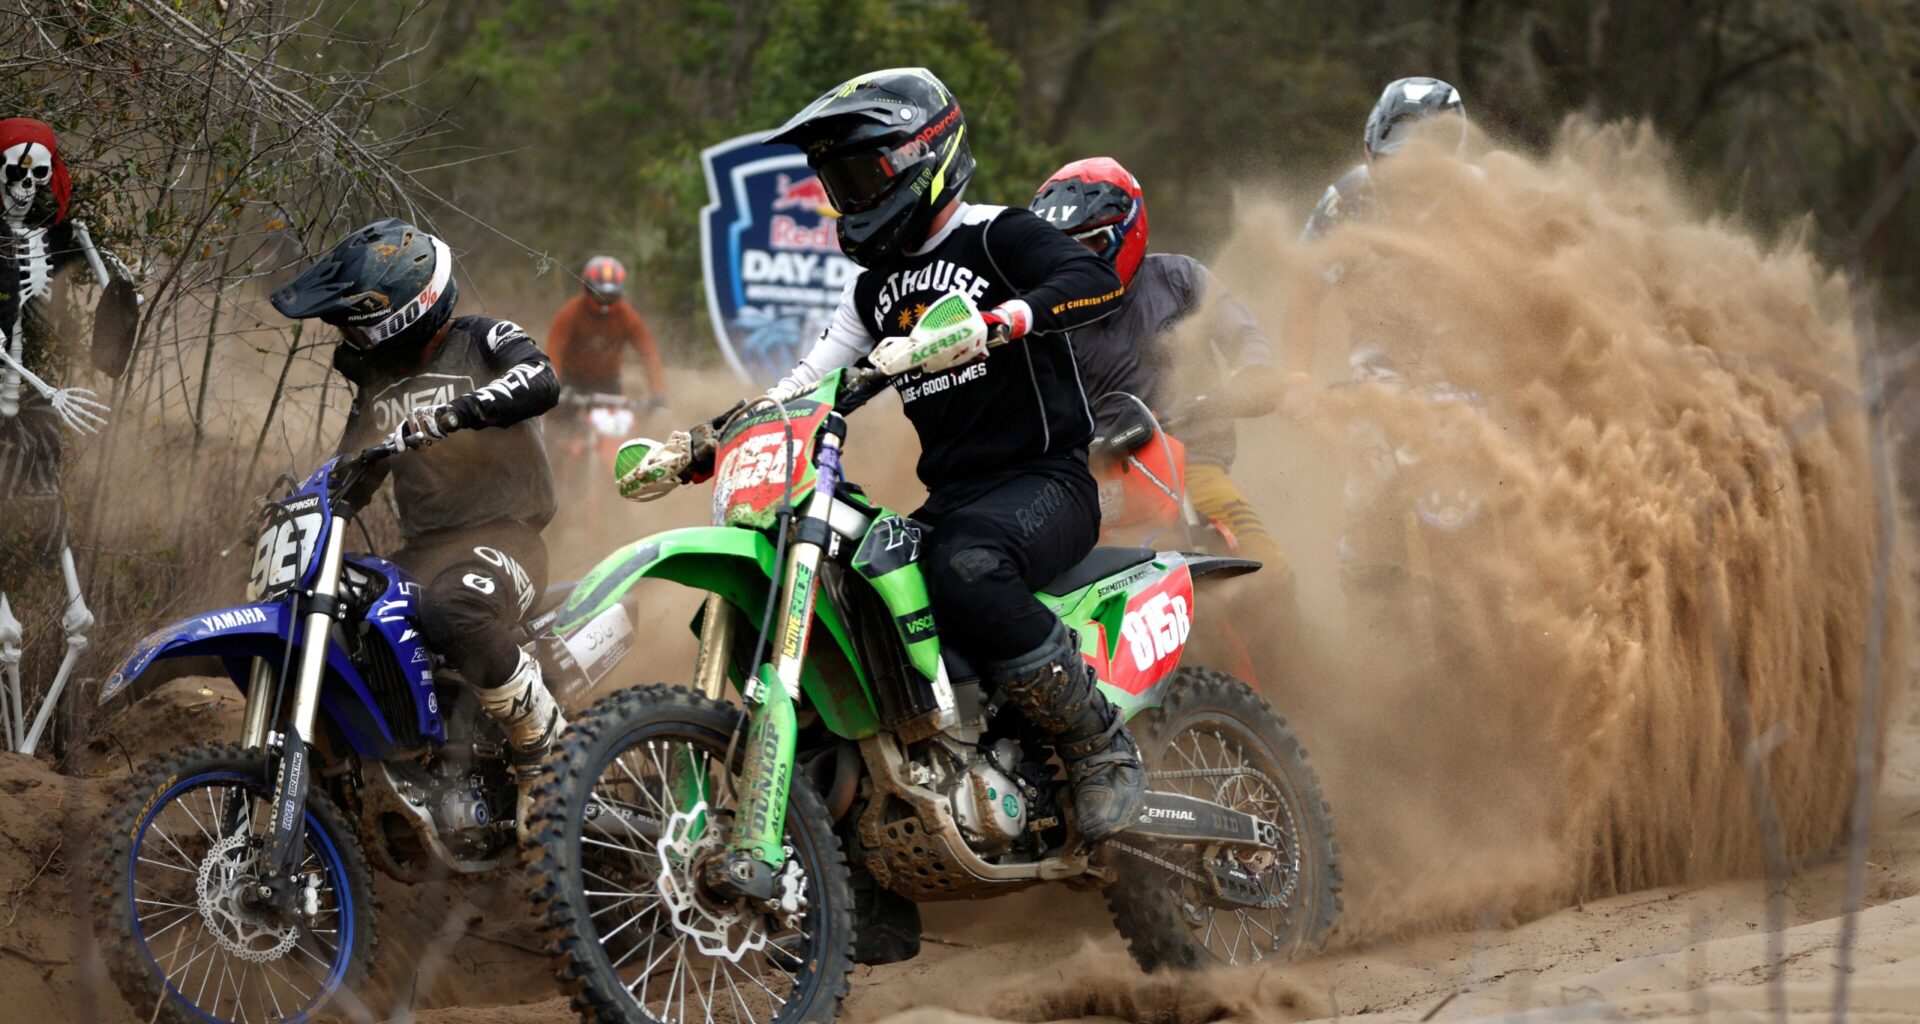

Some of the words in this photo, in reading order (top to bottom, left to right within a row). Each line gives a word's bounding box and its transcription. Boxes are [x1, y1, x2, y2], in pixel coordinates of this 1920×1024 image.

[910, 167, 934, 197] FLY
[770, 214, 829, 249] Red
[376, 284, 437, 339] 100%
[1051, 302, 1066, 315] WE
[1067, 297, 1102, 309] CHERISH
[910, 327, 974, 365] ACERBIS
[922, 375, 951, 397] GOOD
[201, 607, 267, 632] YAMAHA
[1121, 591, 1190, 672] 815B
[289, 752, 302, 797] BRAKING
[754, 721, 779, 836] DUNLOP
[269, 757, 286, 835] DUNLOP
[283, 799, 295, 831] KYB
[772, 762, 788, 836] ACERBIS
